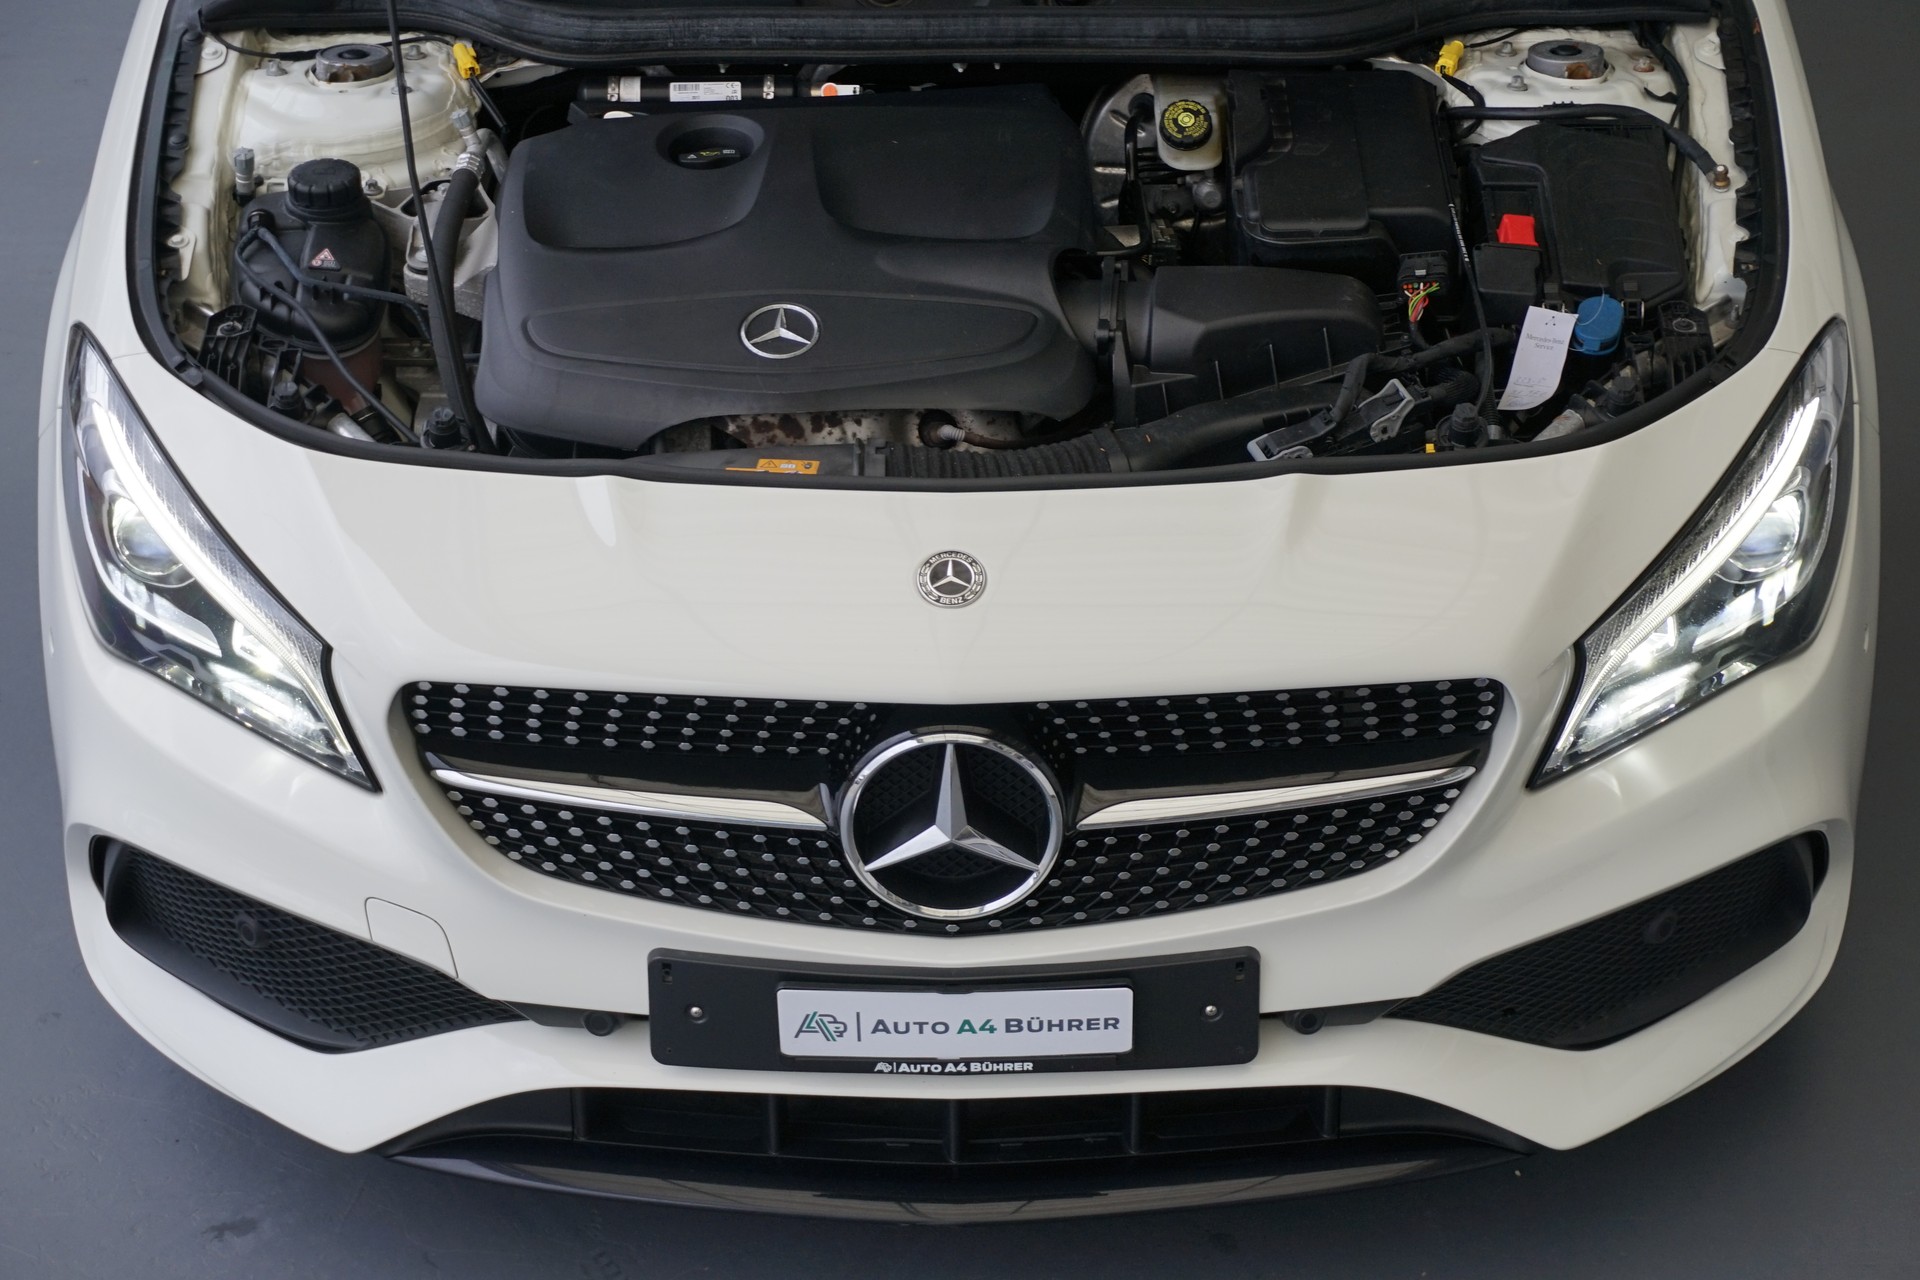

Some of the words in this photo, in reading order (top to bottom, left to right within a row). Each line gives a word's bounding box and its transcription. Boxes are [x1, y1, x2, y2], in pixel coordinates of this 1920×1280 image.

[1526, 333, 1565, 345] Mercedes-Benz
[1534, 343, 1554, 351] Service
[929, 552, 974, 564] MERCEDES
[940, 597, 964, 605] BENZ
[870, 1018, 950, 1035] AUTO
[956, 1018, 997, 1035] A4
[1004, 1016, 1120, 1034] BÜHRER
[898, 1062, 942, 1073] AUTO
[944, 1062, 968, 1073] A4
[970, 1061, 1033, 1072] BÜHRER
